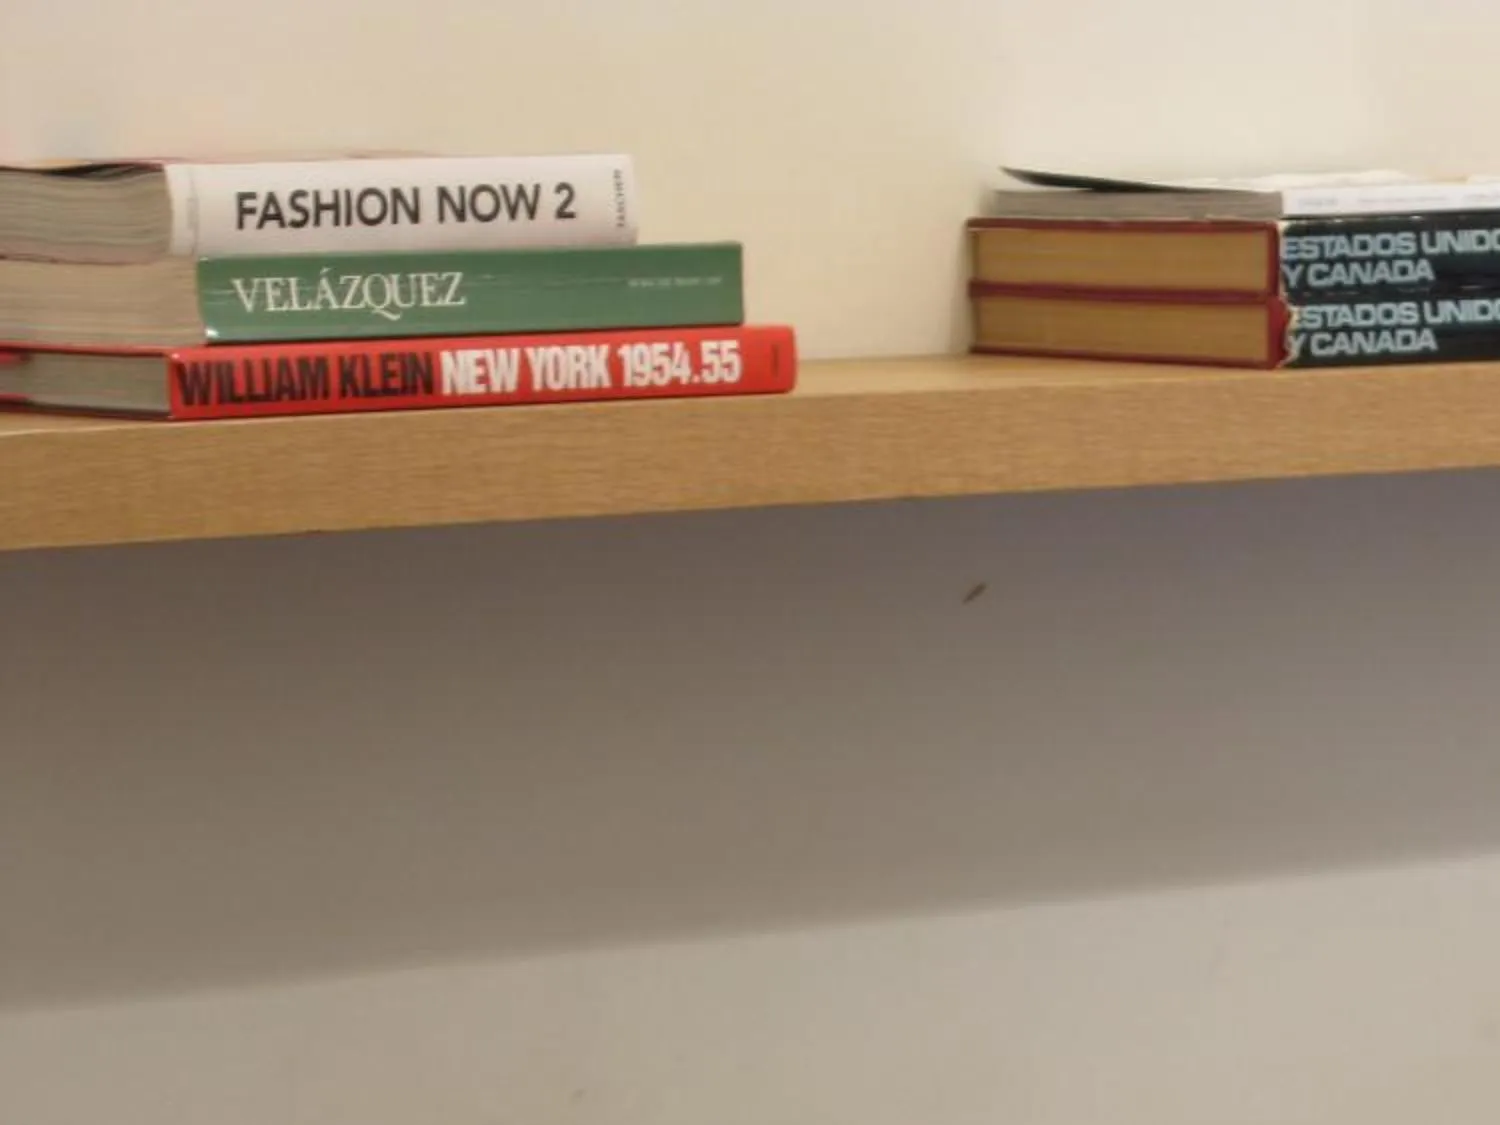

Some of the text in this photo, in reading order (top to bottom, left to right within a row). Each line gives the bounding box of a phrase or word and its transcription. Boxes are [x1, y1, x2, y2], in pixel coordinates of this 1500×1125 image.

[235, 186, 420, 230] FASHION
[437, 183, 541, 223] NOW
[554, 182, 577, 219] 2
[1283, 231, 1417, 262] ESTADOS
[1281, 258, 1435, 288] Y CANADA
[231, 267, 467, 321] VELÁZQUEZ
[1310, 327, 1438, 356] CANADA
[178, 355, 330, 406] WILLIAM
[338, 351, 434, 398] KLEIN
[441, 348, 518, 396] NEW
[527, 343, 612, 392] YORK
[617, 340, 742, 389] 1954.55
